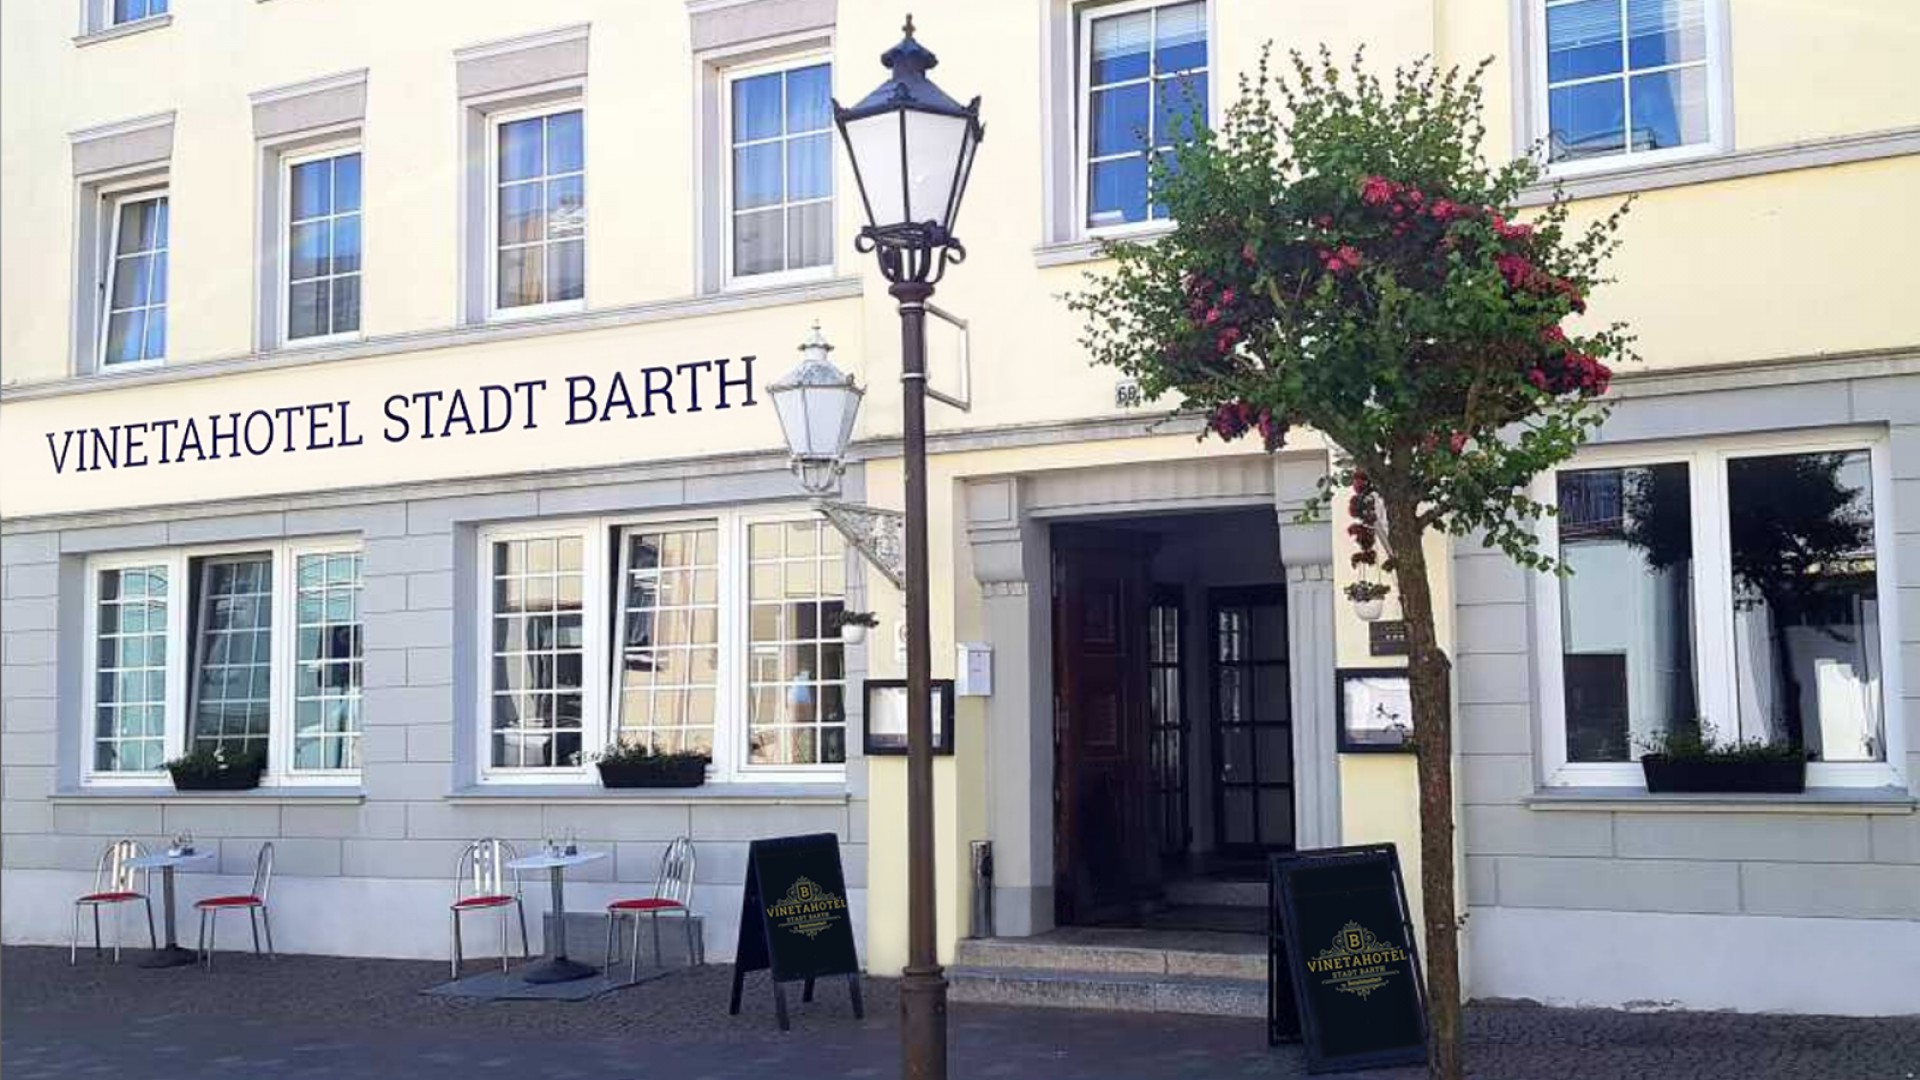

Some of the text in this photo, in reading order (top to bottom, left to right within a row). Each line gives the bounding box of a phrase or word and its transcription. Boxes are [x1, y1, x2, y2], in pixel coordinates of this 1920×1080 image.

[46, 356, 757, 473] VINETAHOTEL STADT BARTH
[799, 886, 810, 898] B
[766, 898, 847, 918] VINETAHOTEL
[1349, 934, 1361, 948] B
[1307, 949, 1408, 973] VINETAHOTEL
